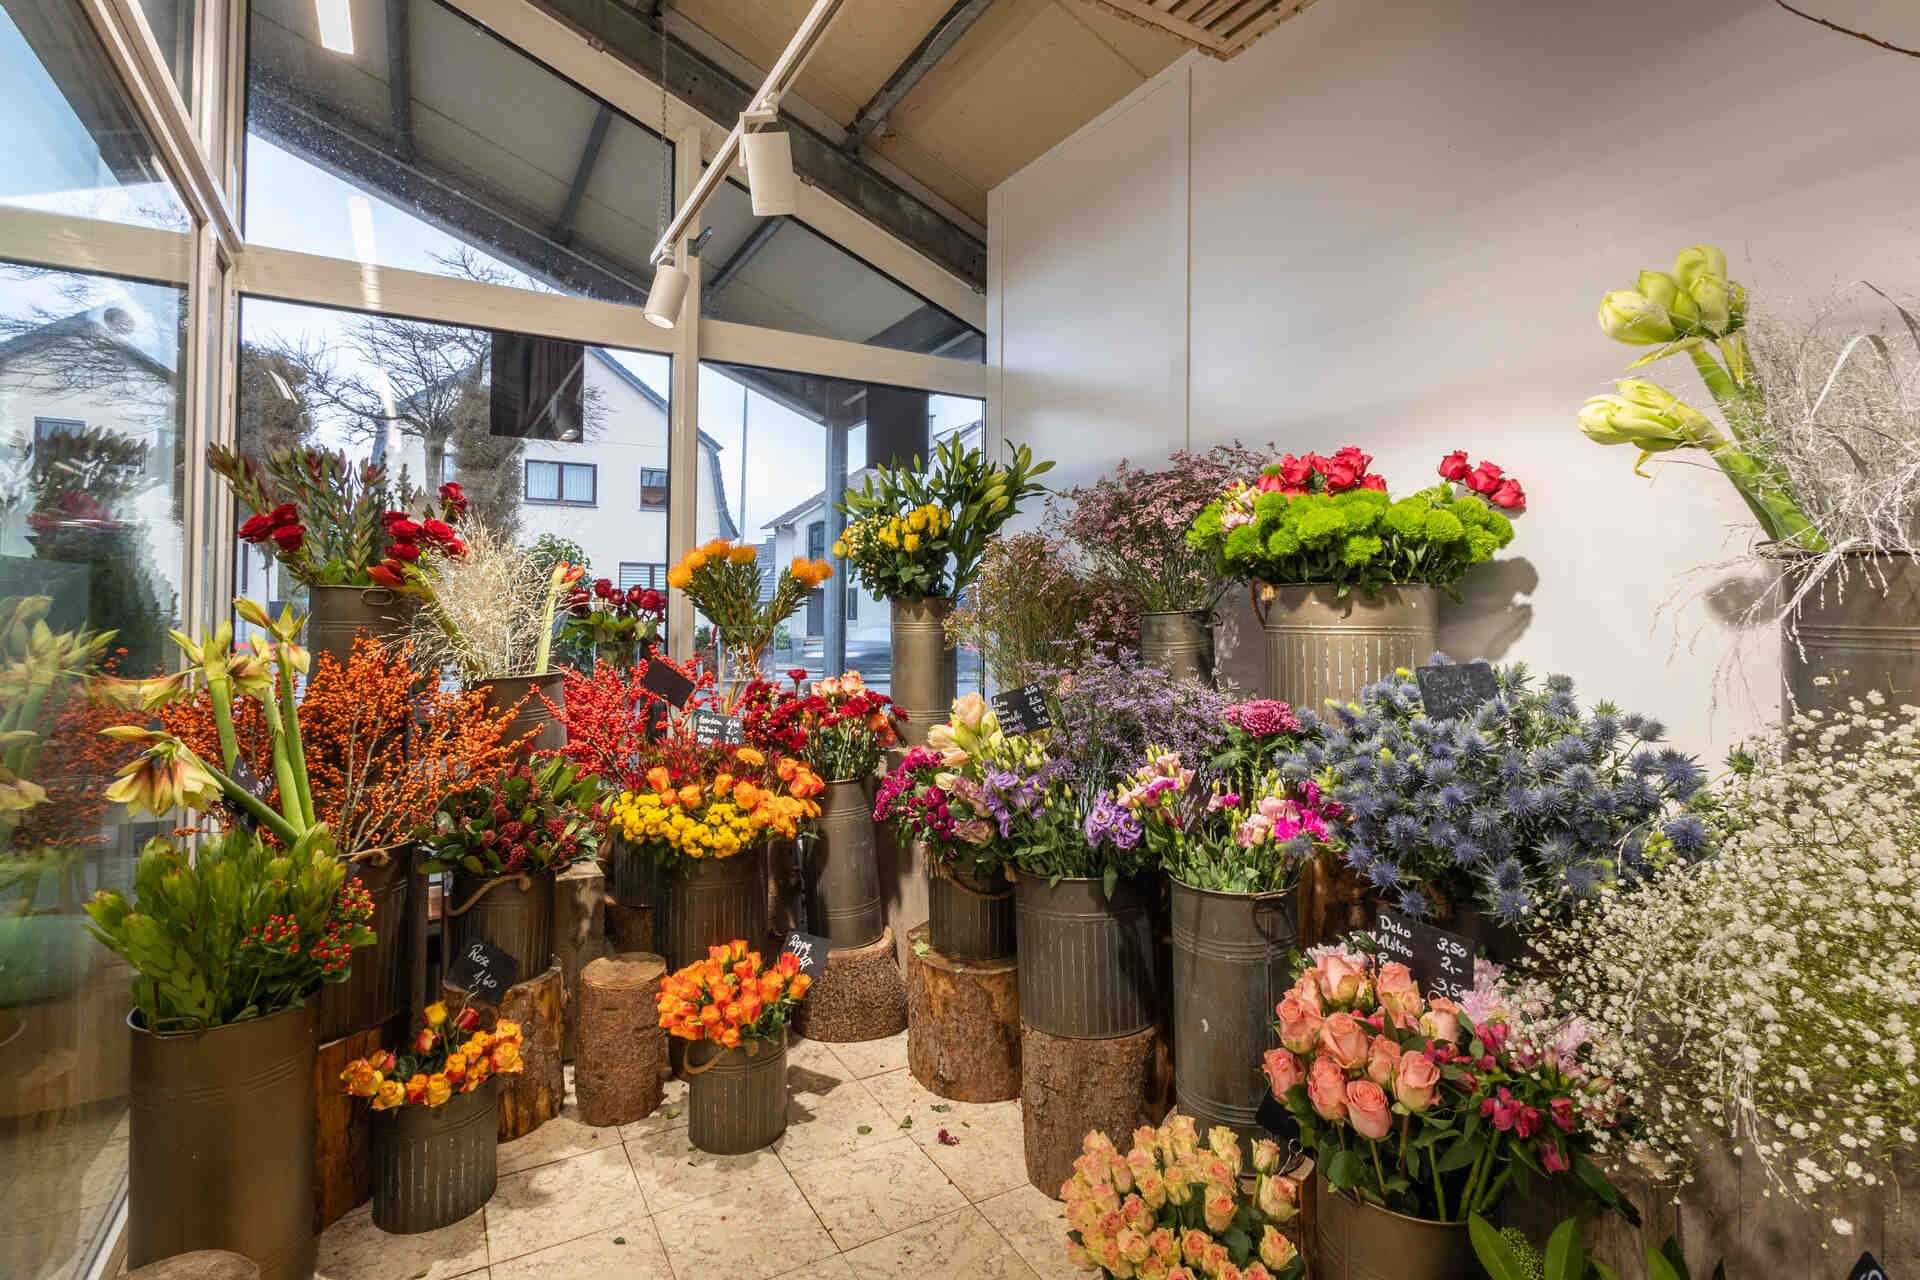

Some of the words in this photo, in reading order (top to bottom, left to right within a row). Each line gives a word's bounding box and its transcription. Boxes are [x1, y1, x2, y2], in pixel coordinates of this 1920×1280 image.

[1380, 914, 1412, 938] Deko
[1437, 937, 1467, 957] 3,50
[1431, 977, 1465, 998] 3,5
